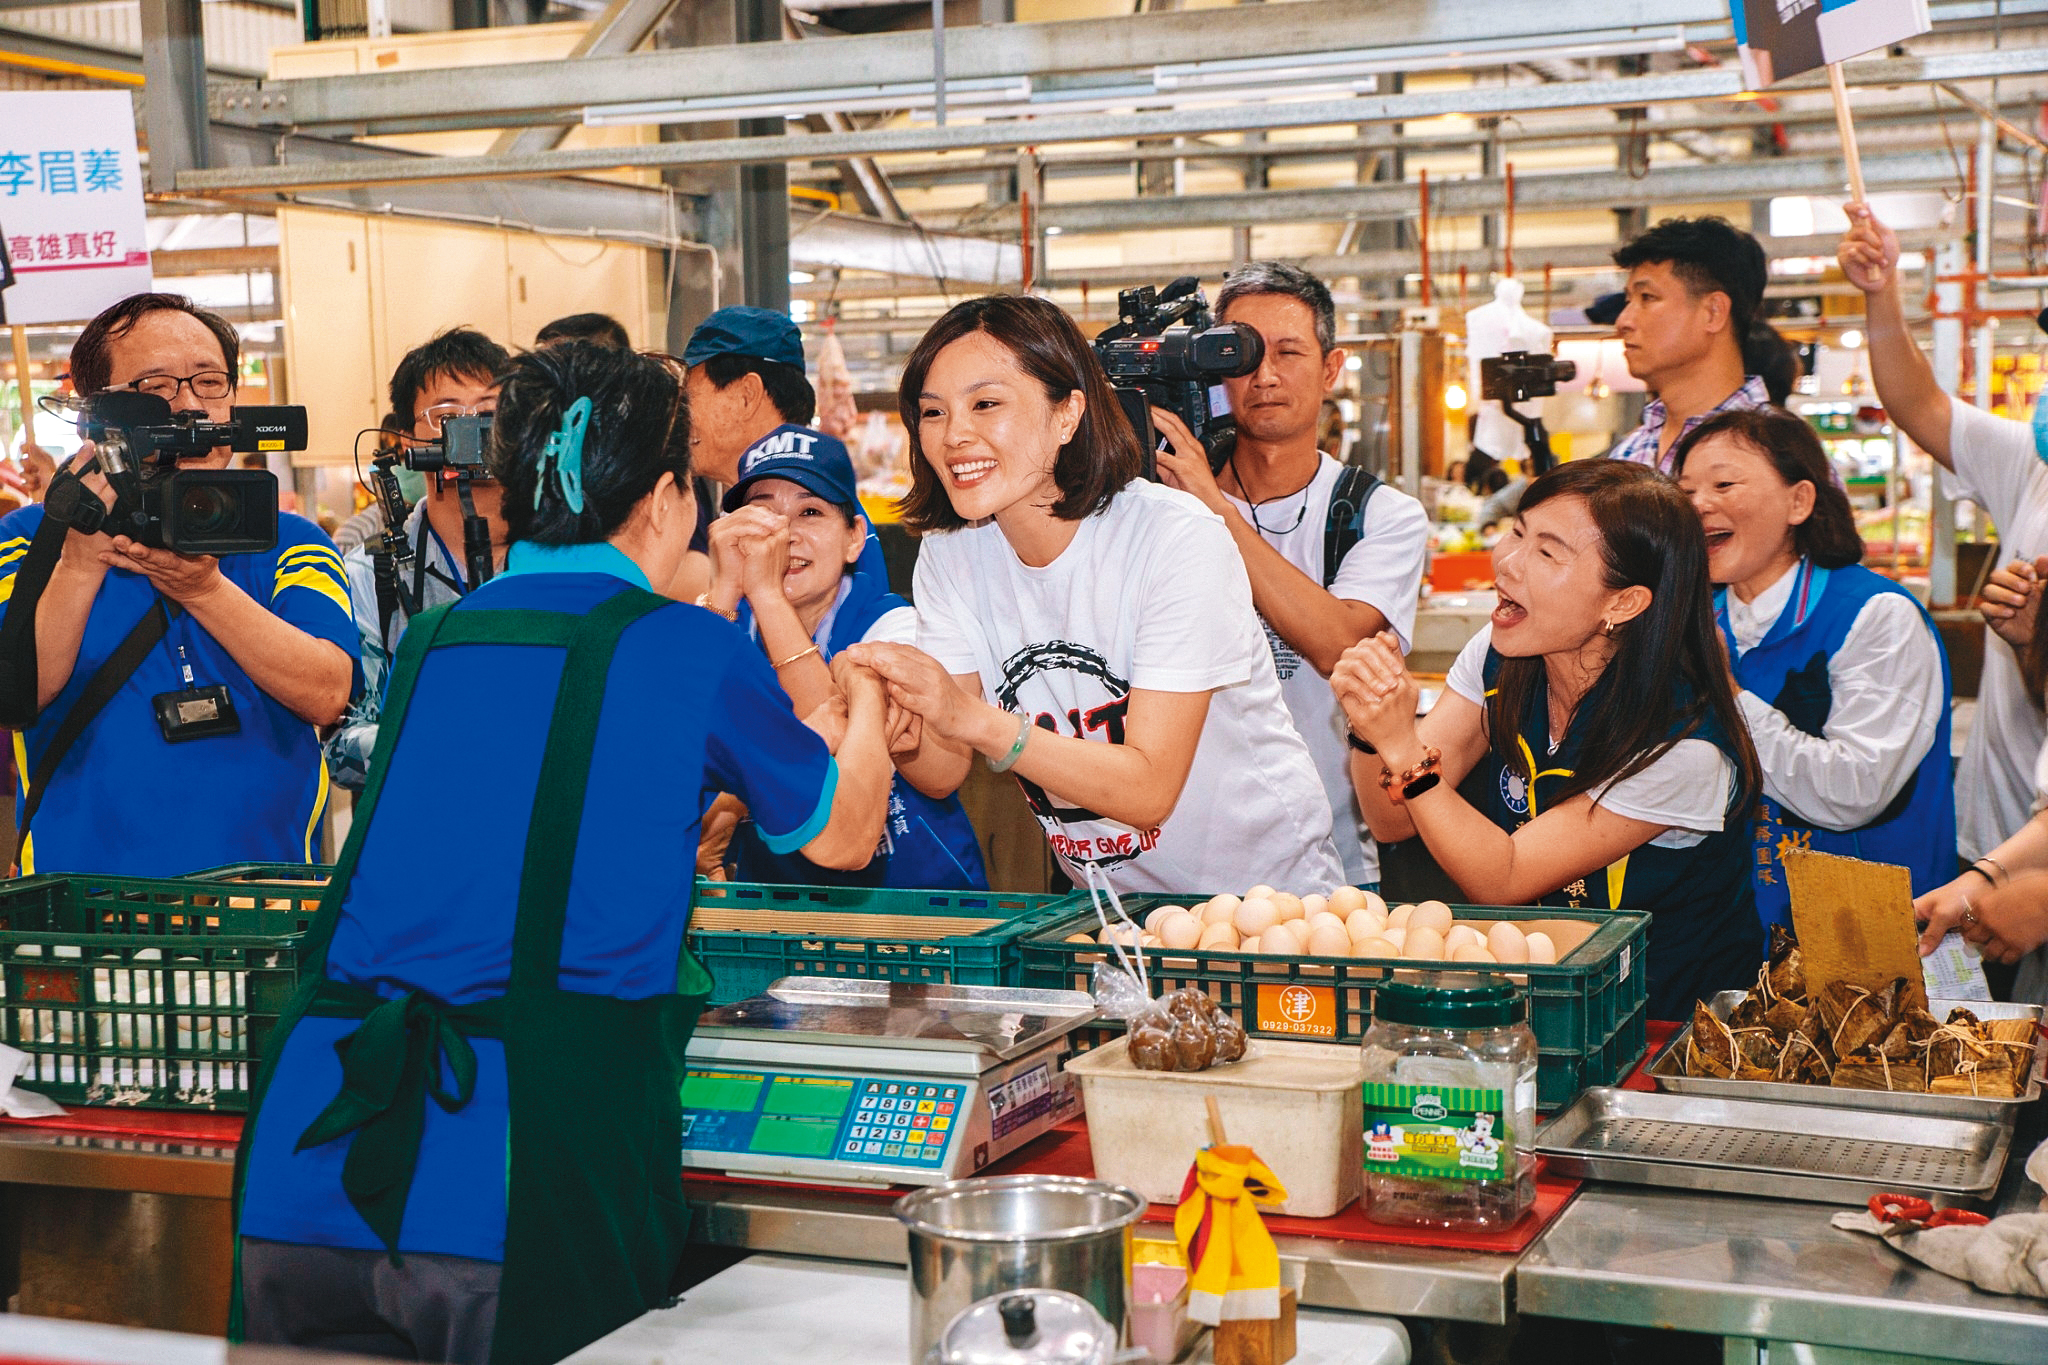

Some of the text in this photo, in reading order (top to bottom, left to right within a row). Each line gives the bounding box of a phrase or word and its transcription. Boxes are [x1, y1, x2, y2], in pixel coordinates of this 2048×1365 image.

[0, 149, 123, 196] 李眉蓁
[9, 230, 116, 264] 高雄真好
[745, 431, 818, 468] KMT
[1276, 670, 1294, 680] UP
[1096, 833, 1133, 855] GIVE
[1139, 828, 1161, 852] UP
[1286, 991, 1311, 1020] 津
[1262, 1020, 1332, 1035] 0929-037322
[868, 1083, 956, 1099] A B C D E
[865, 1098, 874, 1107] 7
[883, 1099, 892, 1109] 8
[903, 1100, 912, 1110] 9
[859, 1112, 868, 1121] 4
[878, 1114, 888, 1123] 5
[898, 1115, 906, 1125] 6
[856, 1127, 863, 1137] 1
[873, 1129, 883, 1138] 2
[892, 1130, 901, 1140] 3
[849, 1141, 858, 1151] 0
